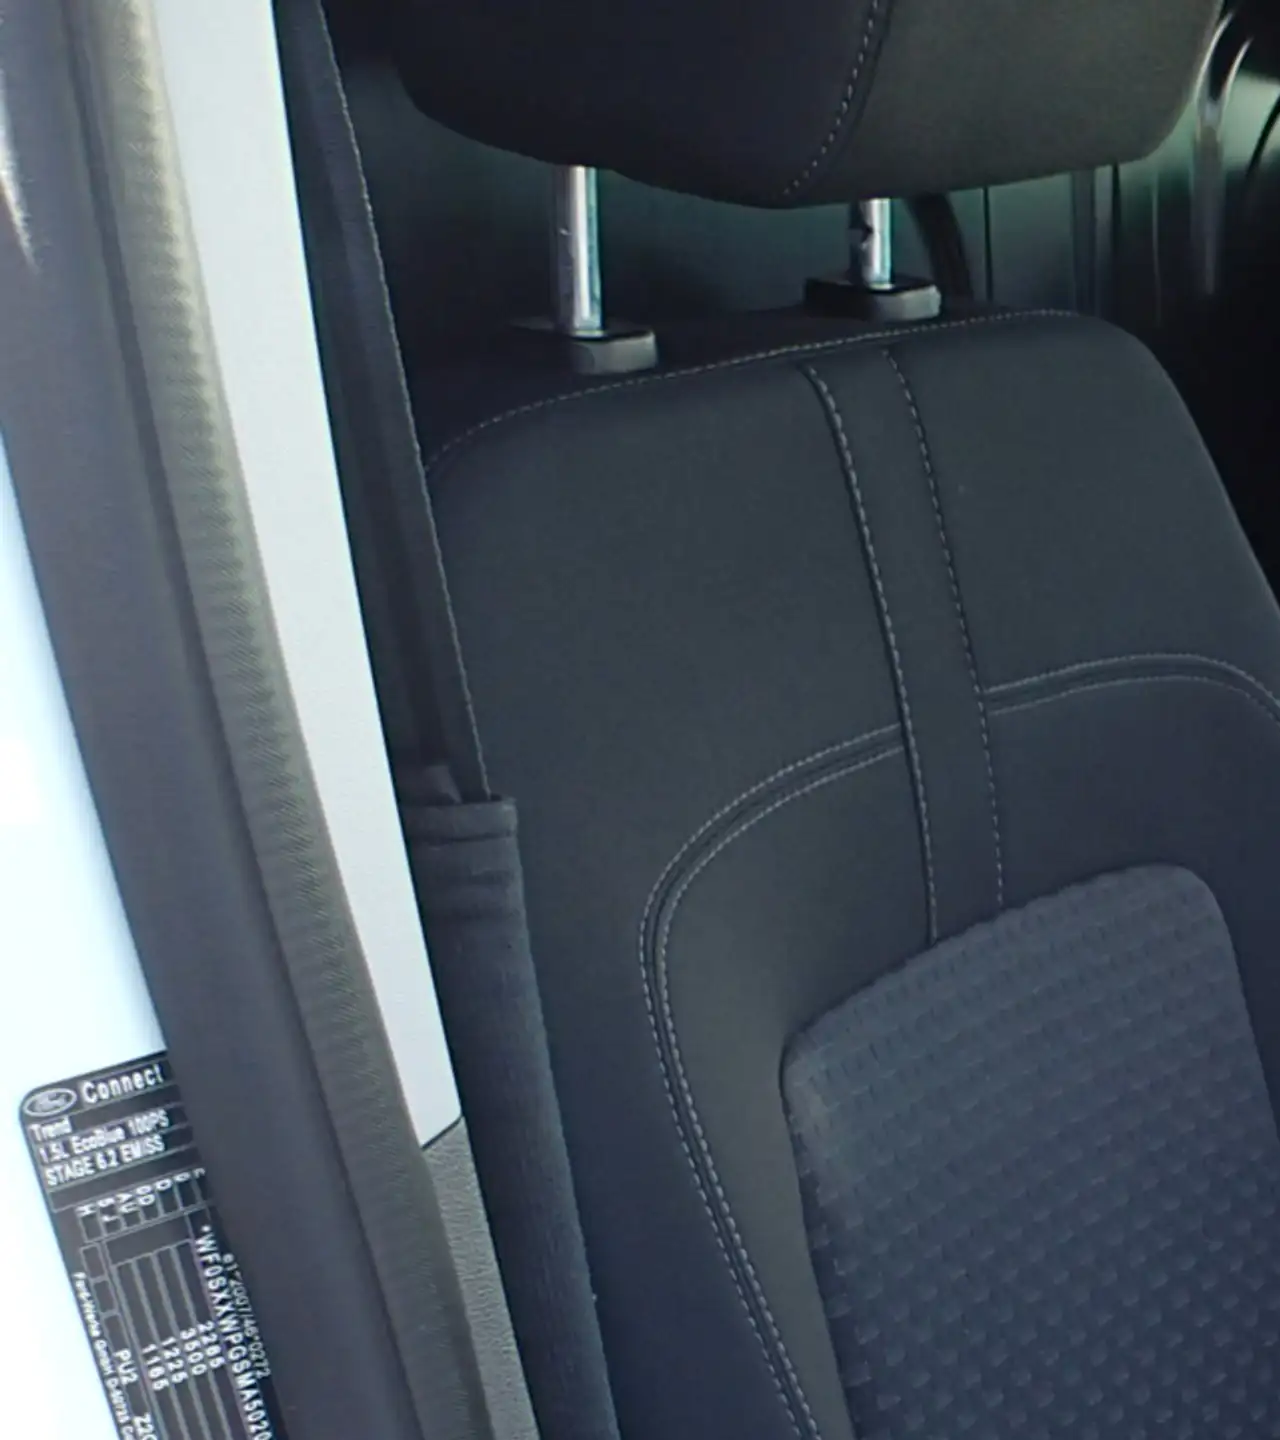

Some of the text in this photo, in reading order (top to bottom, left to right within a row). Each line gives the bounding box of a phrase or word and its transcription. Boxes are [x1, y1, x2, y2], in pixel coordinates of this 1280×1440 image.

[81, 1063, 164, 1104] Connect
[46, 1156, 95, 1186] STAGE
[114, 1349, 138, 1384] PU2
[161, 1336, 188, 1384] 1225
[180, 1327, 207, 1376] 3500
